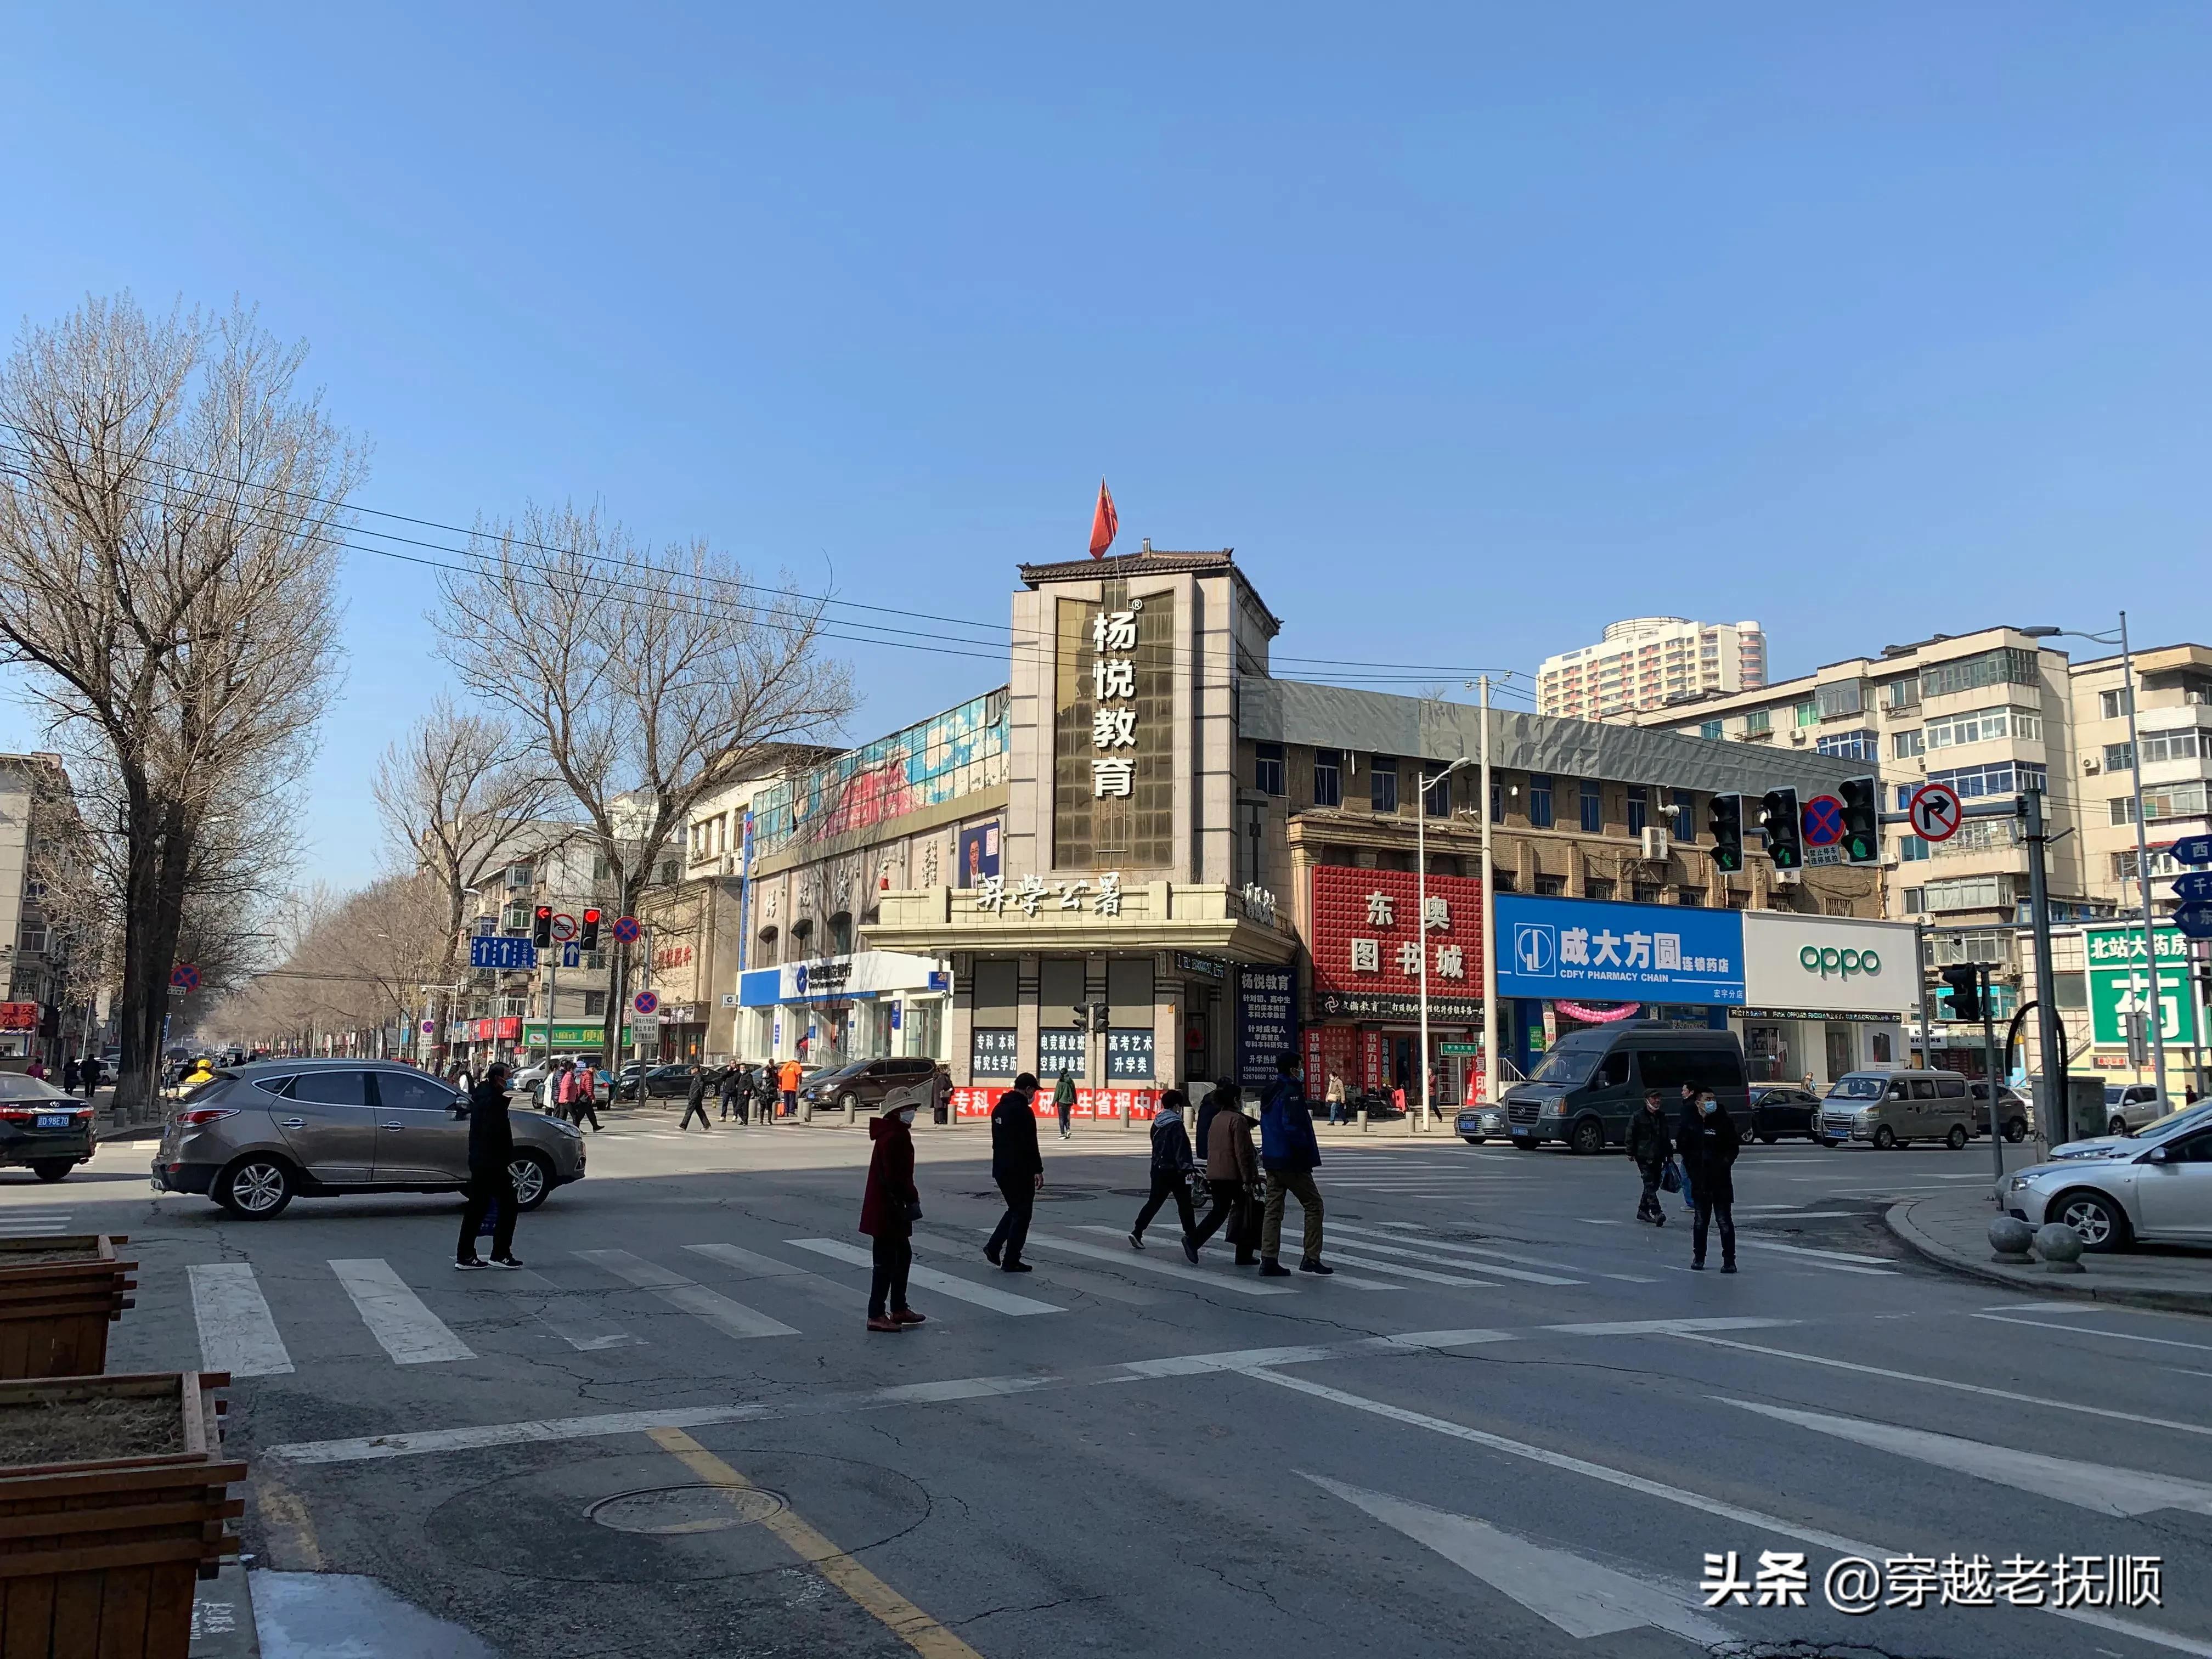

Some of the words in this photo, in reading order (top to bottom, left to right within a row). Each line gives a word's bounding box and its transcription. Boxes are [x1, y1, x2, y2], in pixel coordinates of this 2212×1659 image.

[1092, 611, 1136, 797] 杨悦教育
[2194, 878, 2212, 895] 千
[1365, 891, 1450, 930] 东奥
[1560, 927, 1681, 970] 成大方圆
[1682, 956, 1729, 973] 连锁药店
[2091, 933, 2187, 959] 北站大药房
[1352, 938, 1464, 979] 图书城
[1242, 973, 1289, 990] 杨悦教育
[1560, 970, 1584, 979] CDFY
[1588, 971, 1637, 981] PHARMACY
[1641, 974, 1668, 983] CHAIN
[1714, 989, 1743, 999] 宏宇分店
[1392, 1002, 1484, 1015] 打造抚顺性化升学辅导第一品
[2112, 973, 2180, 1039] 药
[1248, 1025, 1286, 1034] 针对成年人
[977, 1034, 994, 1050] 专科
[998, 1034, 1015, 1050] 本科
[1041, 1035, 1085, 1051] 电竞就业班
[1109, 1035, 1153, 1051] 高考艺术
[974, 1055, 1017, 1071] 研究生学历
[1040, 1056, 1085, 1071] 空乘就业班
[1114, 1057, 1147, 1073] 升学类
[953, 1090, 990, 1116] 专科
